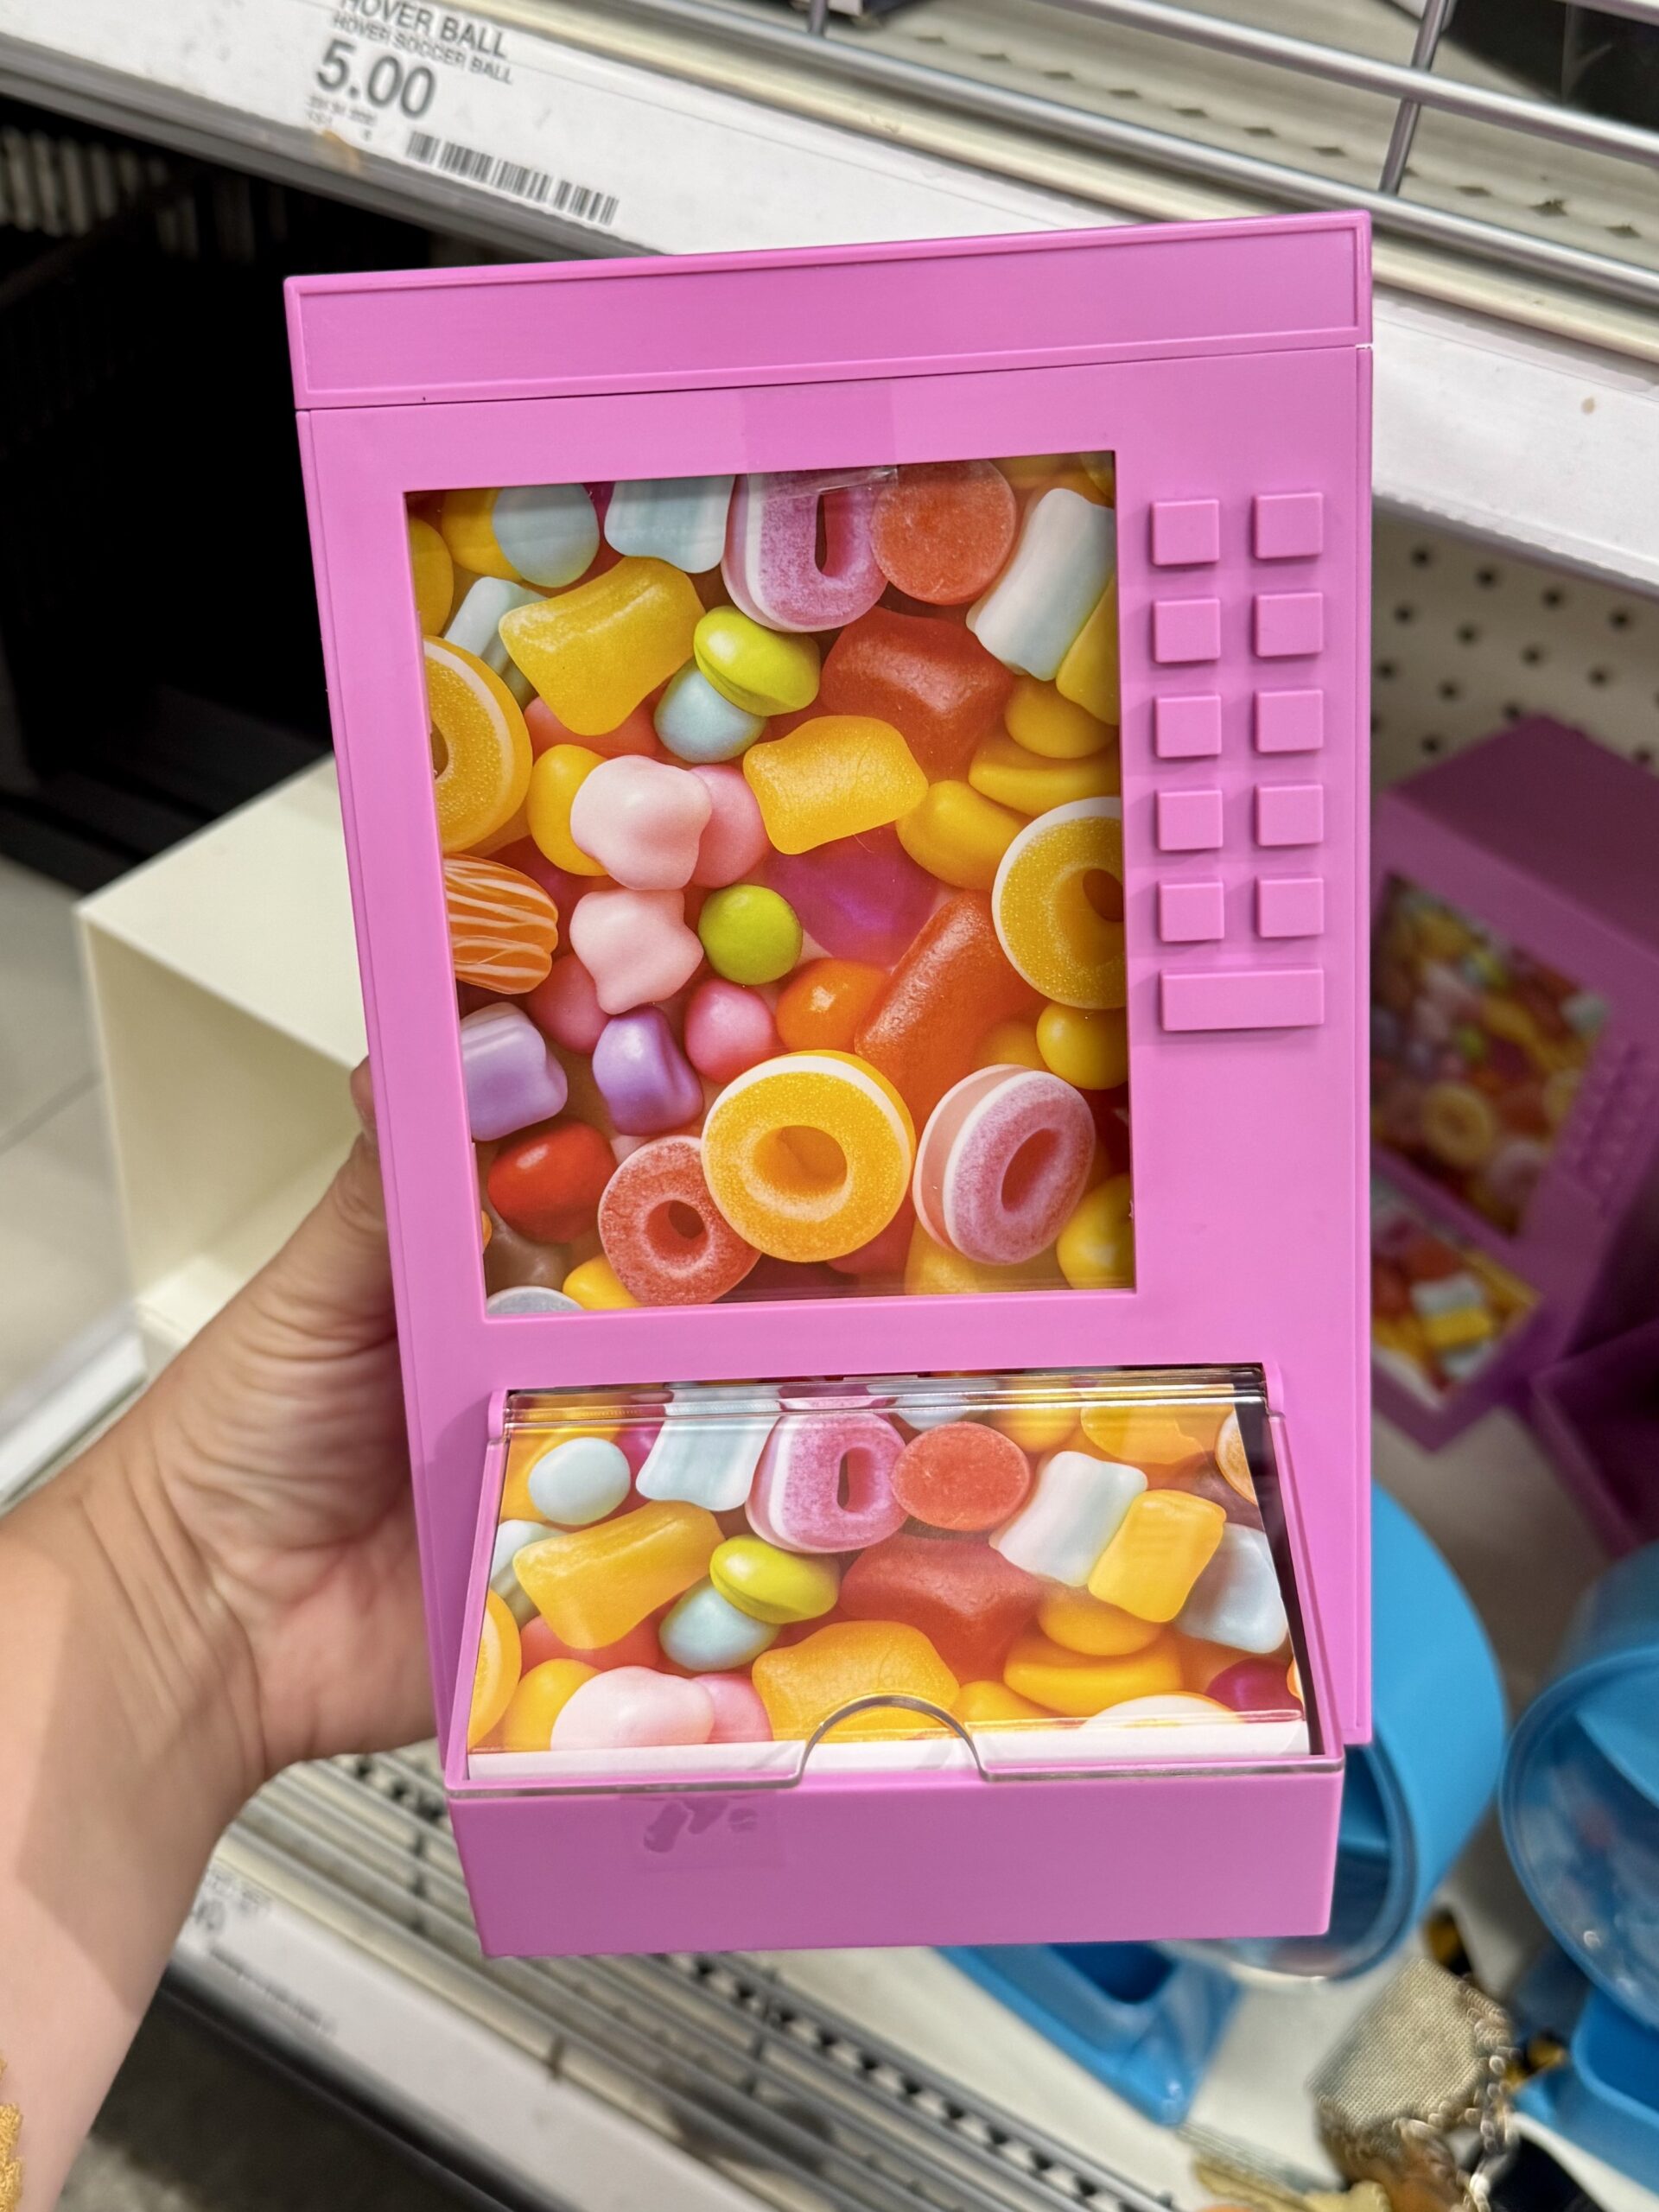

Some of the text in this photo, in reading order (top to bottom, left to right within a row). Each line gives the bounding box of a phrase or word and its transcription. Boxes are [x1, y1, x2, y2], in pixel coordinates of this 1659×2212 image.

[392, 30, 467, 71] SOCCER
[469, 54, 513, 85] BALL
[440, 16, 507, 60] BALL
[316, 38, 436, 119] 5.00
